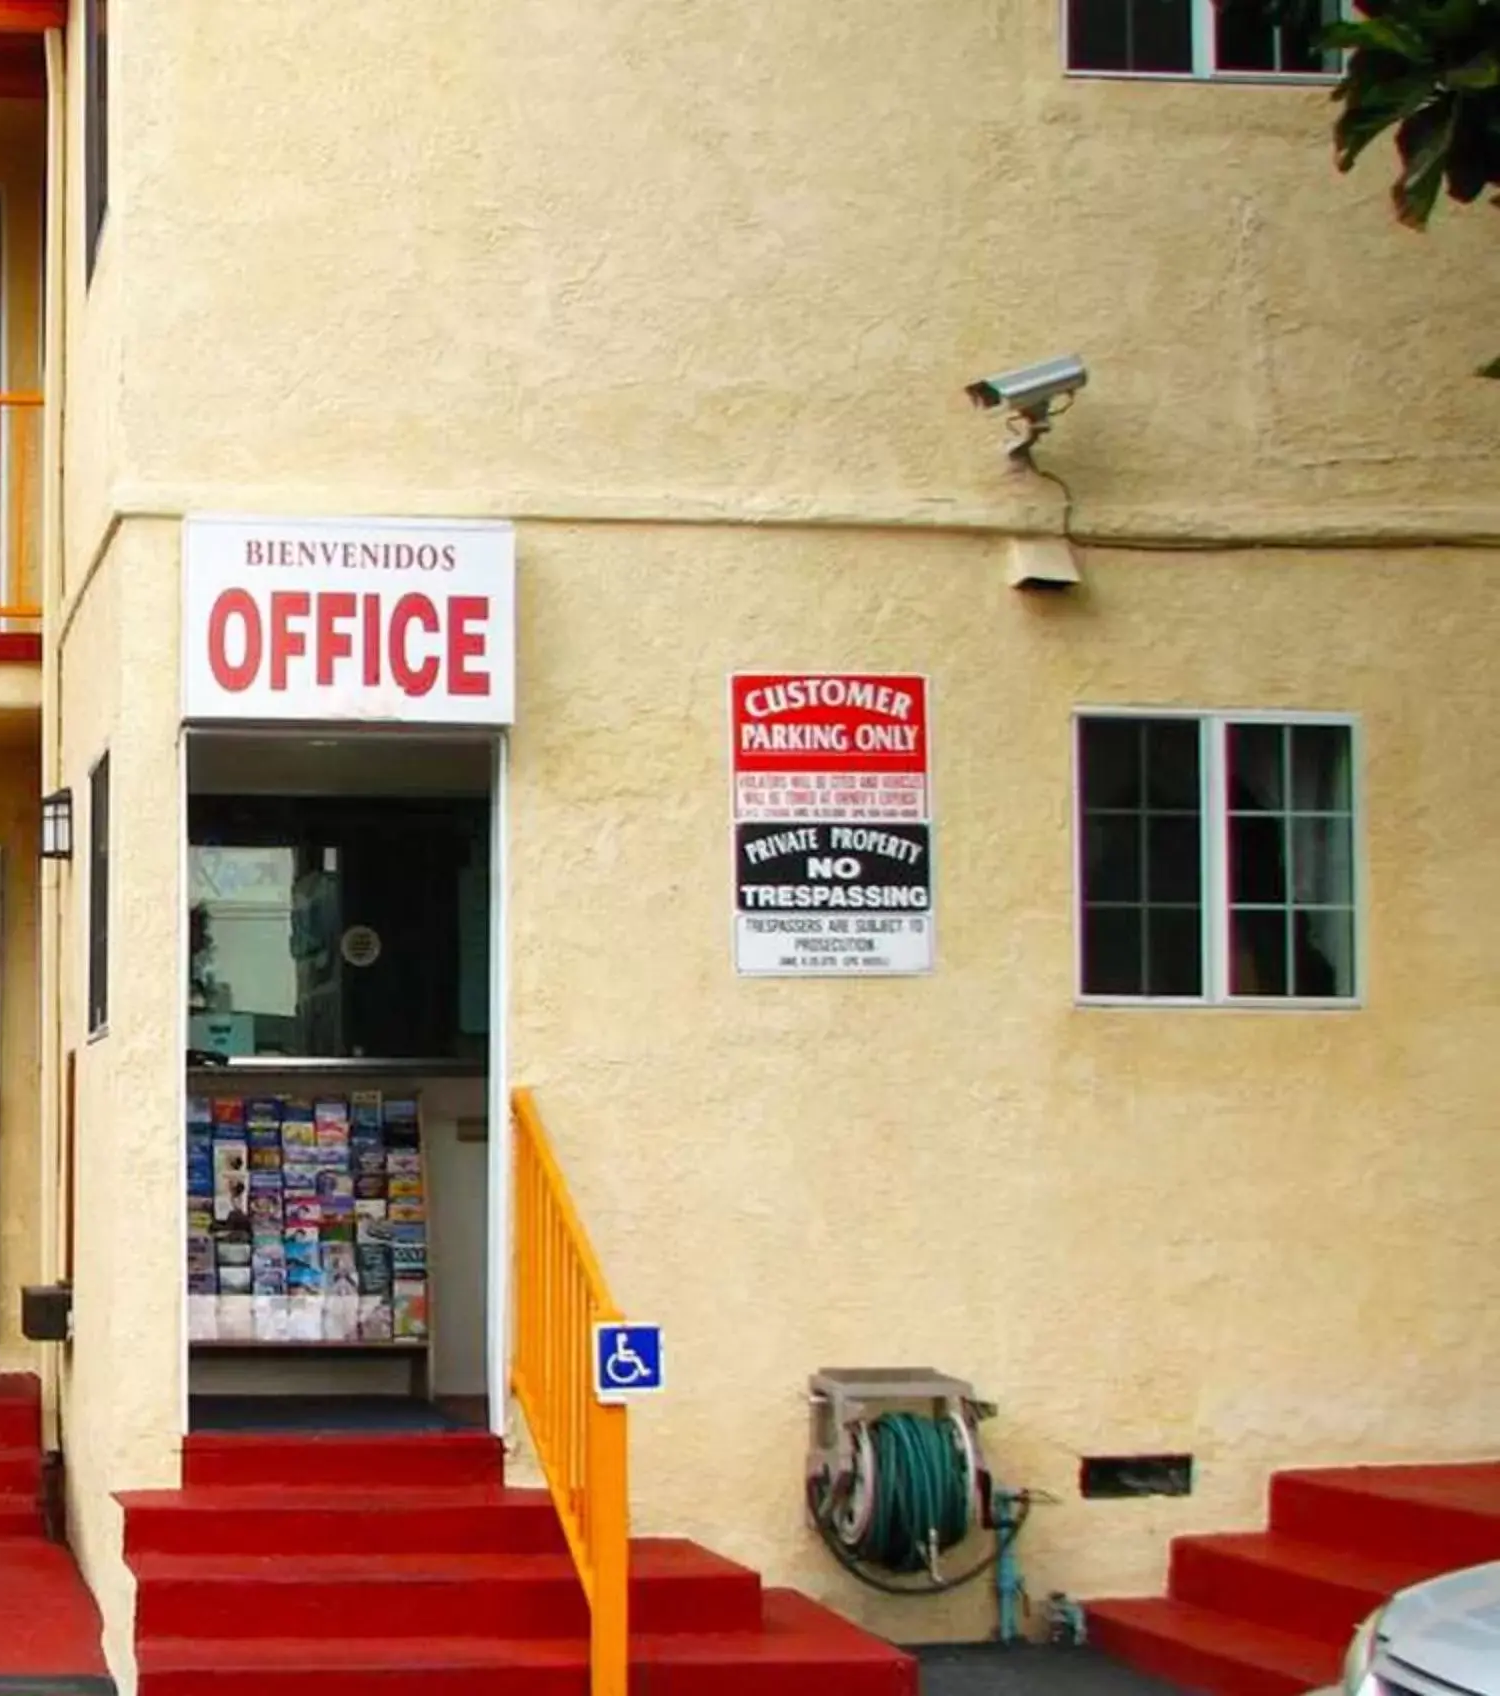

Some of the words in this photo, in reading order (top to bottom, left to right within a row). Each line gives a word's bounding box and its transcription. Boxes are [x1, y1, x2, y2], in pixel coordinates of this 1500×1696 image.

[245, 539, 457, 571] BIENVENIDOS
[208, 587, 490, 697] OFFICE
[744, 678, 912, 720] CUSTOMER
[740, 723, 847, 752] PARKING
[855, 724, 919, 751] ONLY
[743, 827, 818, 865] PRIVATE
[830, 827, 924, 865] PROPERTY
[807, 856, 861, 879] NO
[740, 884, 928, 909] TRESPASSING
[746, 918, 823, 933] TRESPASSERS
[828, 918, 849, 933] ARE
[855, 918, 903, 933] SUBJECT
[909, 918, 924, 933] TO
